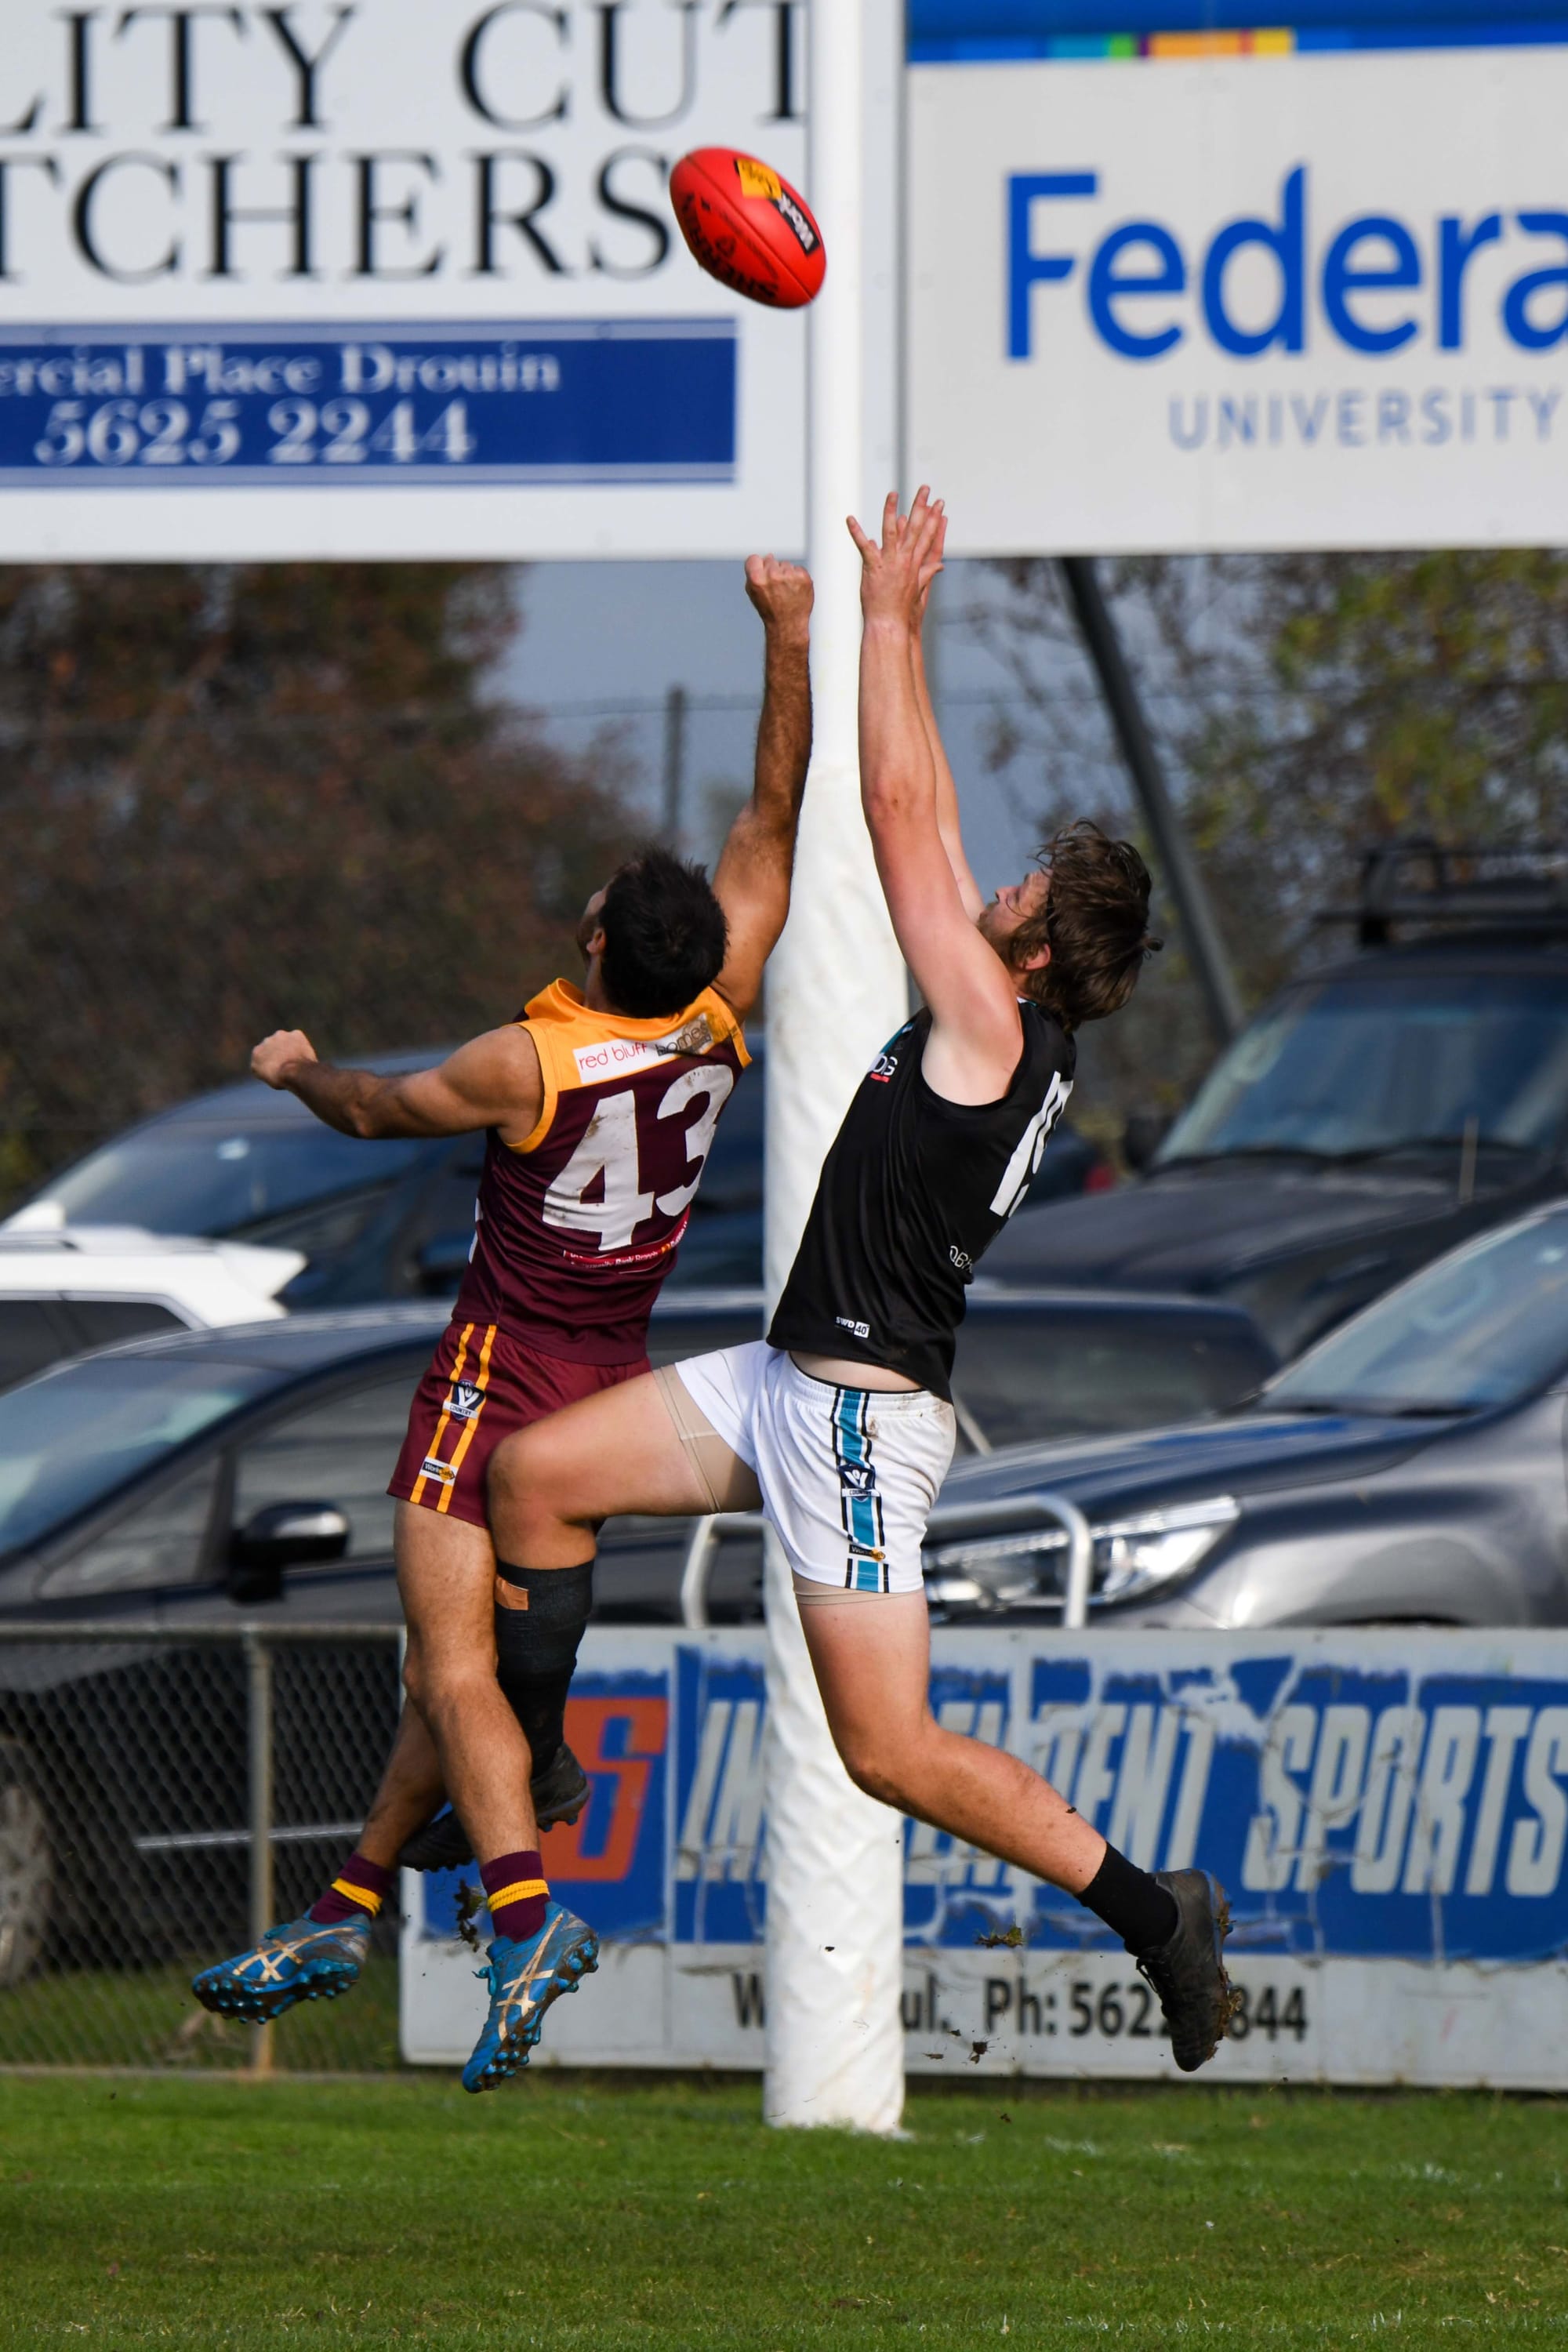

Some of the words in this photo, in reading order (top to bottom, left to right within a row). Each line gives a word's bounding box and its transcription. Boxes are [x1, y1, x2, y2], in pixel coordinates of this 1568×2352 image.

[1004, 160, 1568, 364] Federa
[166, 342, 322, 394] Place
[340, 341, 561, 394] Drouin
[34, 398, 242, 466] 5625
[268, 395, 477, 465] 2244
[1167, 387, 1563, 451] UNIVERSITY
[579, 1048, 608, 1070] red
[612, 1041, 648, 1062] bluff
[542, 1063, 735, 1251] 43
[1241, 1704, 1568, 1899] SPORTS
[985, 1977, 1058, 2036] Ph:
